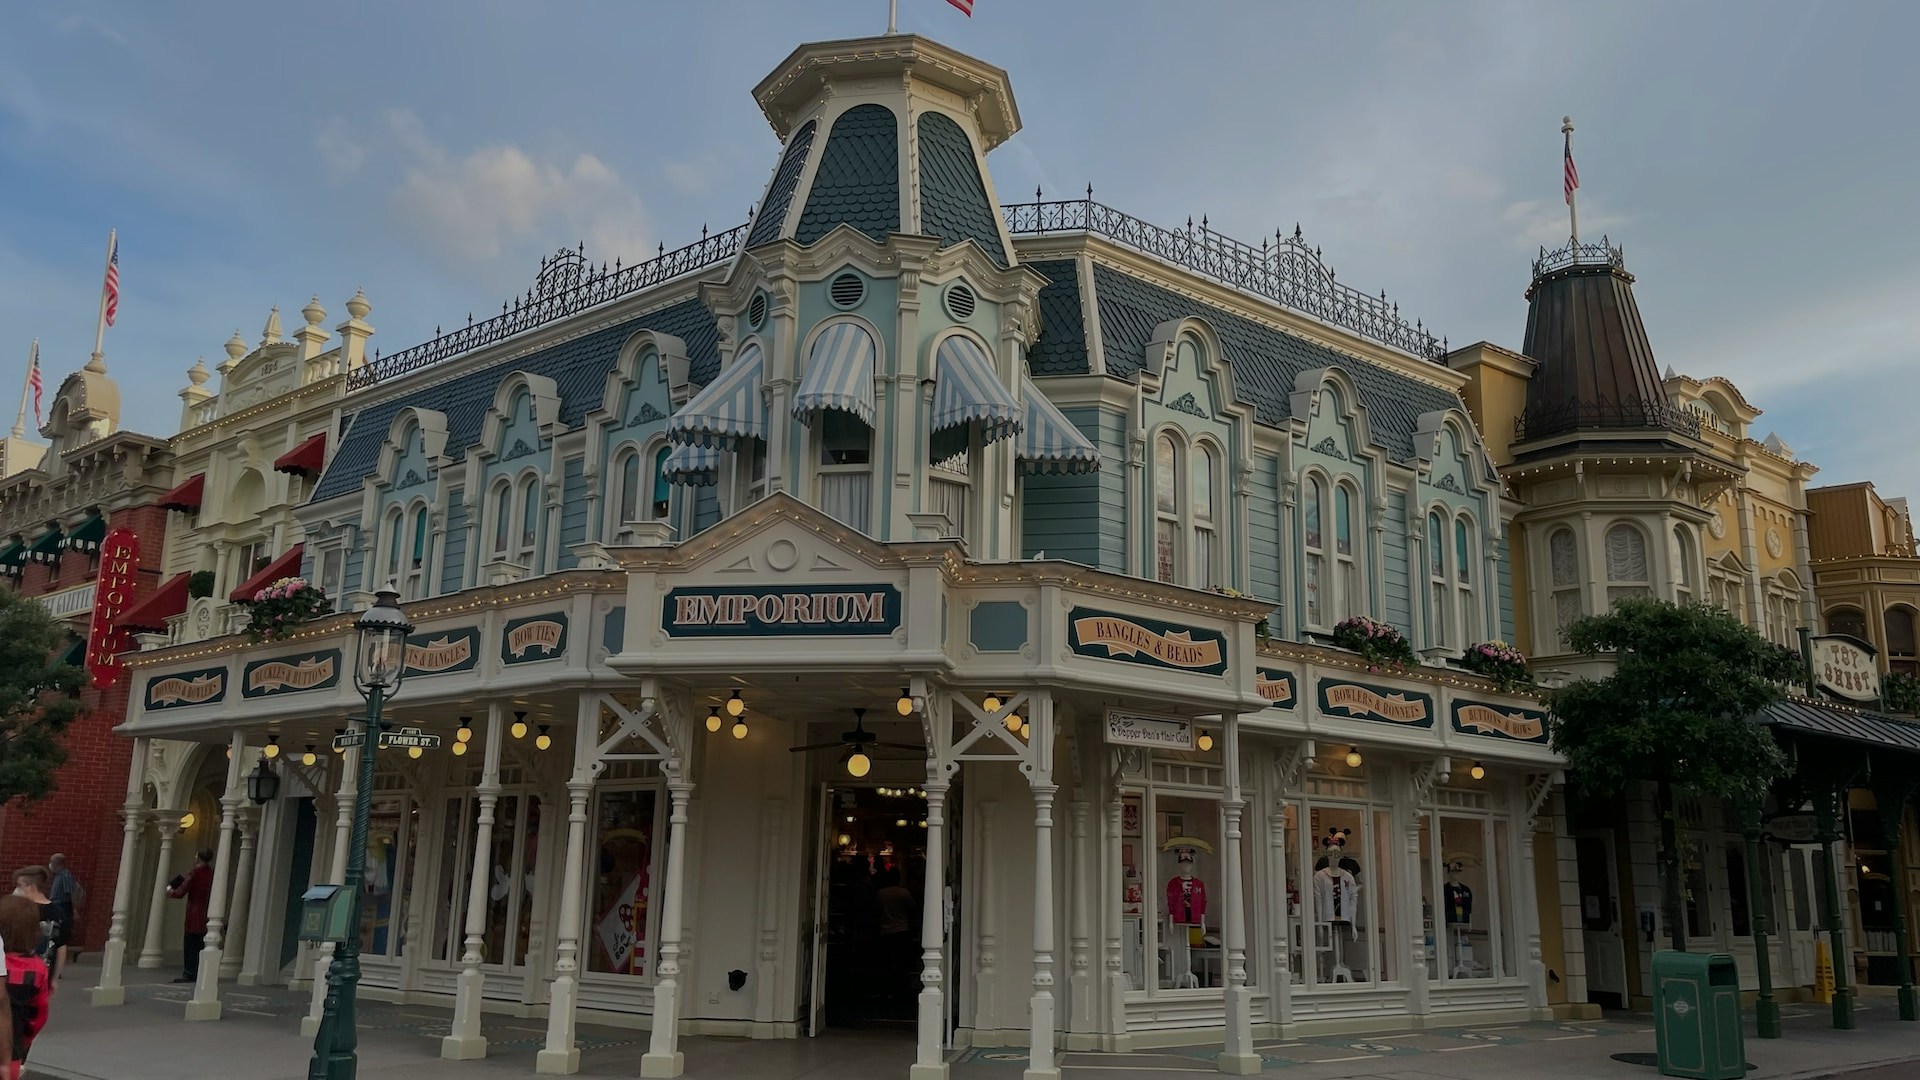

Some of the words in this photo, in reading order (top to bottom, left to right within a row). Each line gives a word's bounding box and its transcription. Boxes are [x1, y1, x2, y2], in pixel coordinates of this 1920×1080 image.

[97, 545, 132, 667] EMPORIUM
[672, 592, 886, 625] EMPORIUM
[514, 628, 533, 648] BOW
[535, 624, 557, 643] TIES
[1096, 621, 1151, 649] BANGLES
[1154, 640, 1162, 656] &
[1167, 643, 1204, 663] BEADS
[427, 644, 467, 667] BANGLES
[1830, 645, 1859, 669] TOY
[254, 663, 285, 684] BUCKLES
[292, 667, 327, 685] BUTTONS
[1256, 683, 1286, 699] OCHES
[1333, 688, 1373, 706] BOWLERS
[1374, 699, 1380, 711] &
[1383, 702, 1420, 719] BONNETS
[1468, 708, 1501, 724] BUTTONS
[388, 736, 419, 746] FLOWER
